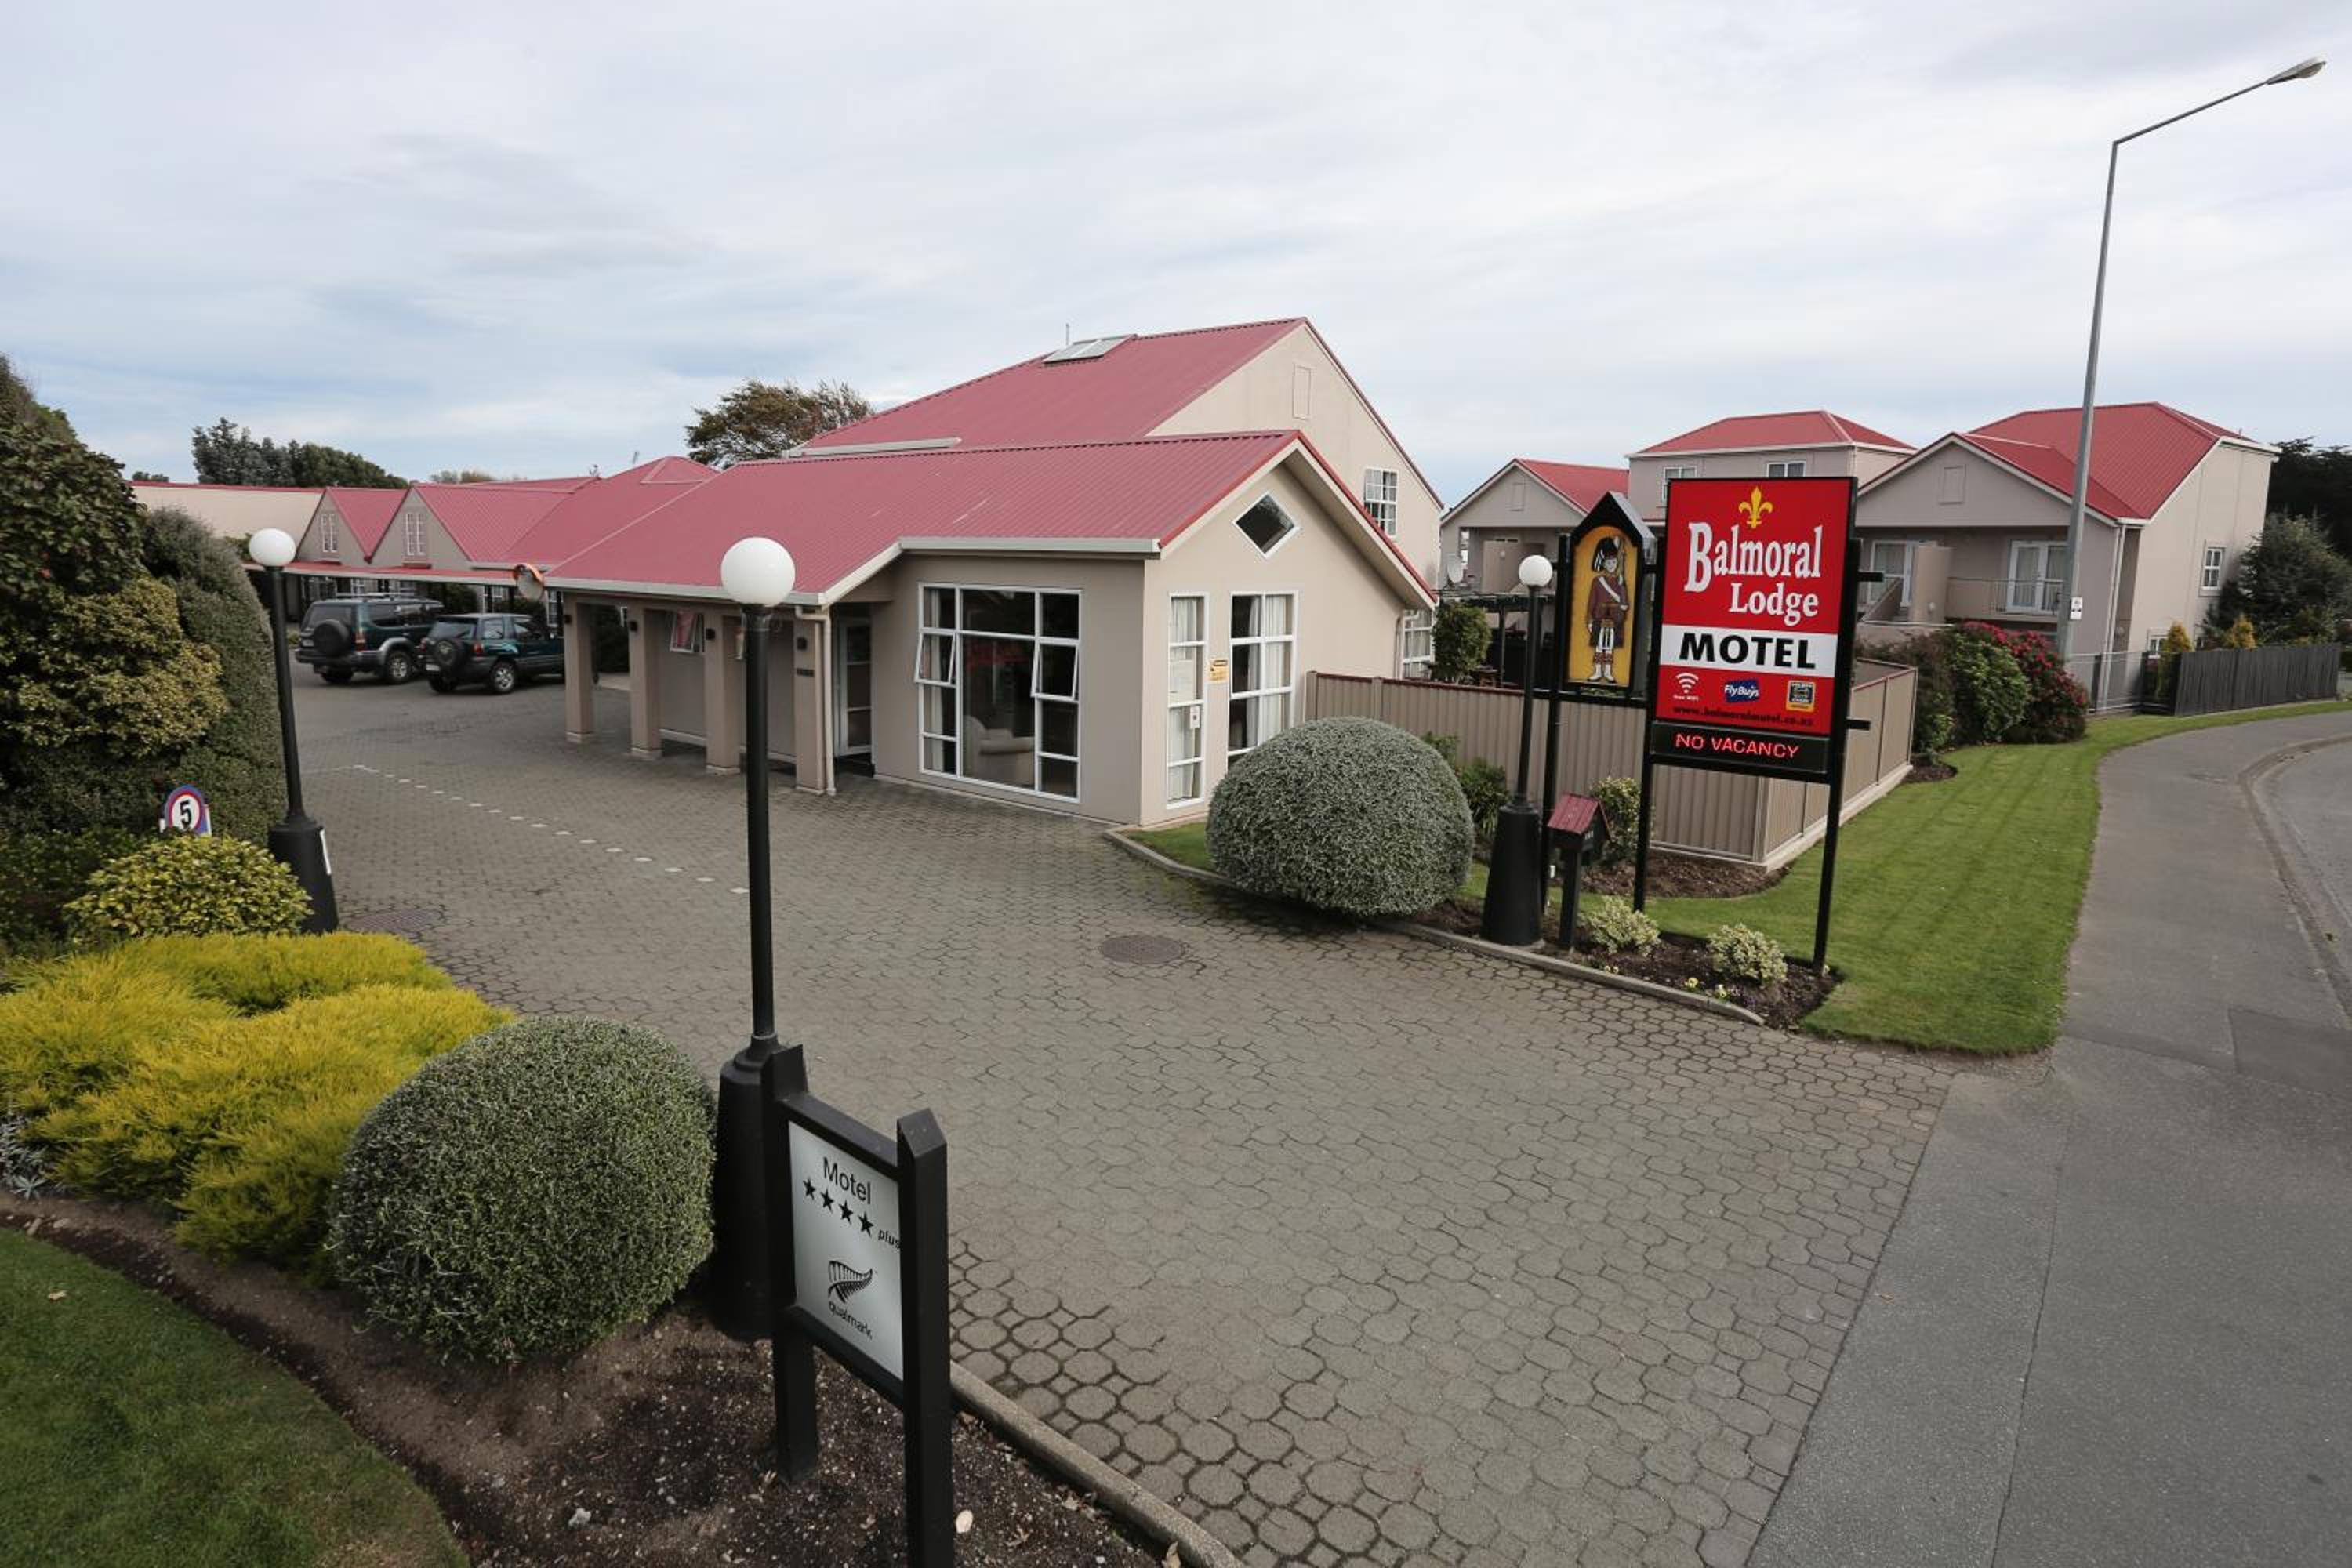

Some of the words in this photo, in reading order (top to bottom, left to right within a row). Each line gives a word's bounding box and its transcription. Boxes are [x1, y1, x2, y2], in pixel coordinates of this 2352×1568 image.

[1684, 521, 1823, 593] Balmoral
[1729, 582, 1819, 627] Lodge
[1679, 632, 1817, 670] MOTEL
[1675, 733, 1704, 750] NO
[1711, 736, 1799, 759] VACANCY
[180, 800, 192, 826] 5
[823, 1156, 871, 1205] Motel
[878, 1229, 900, 1249] plus
